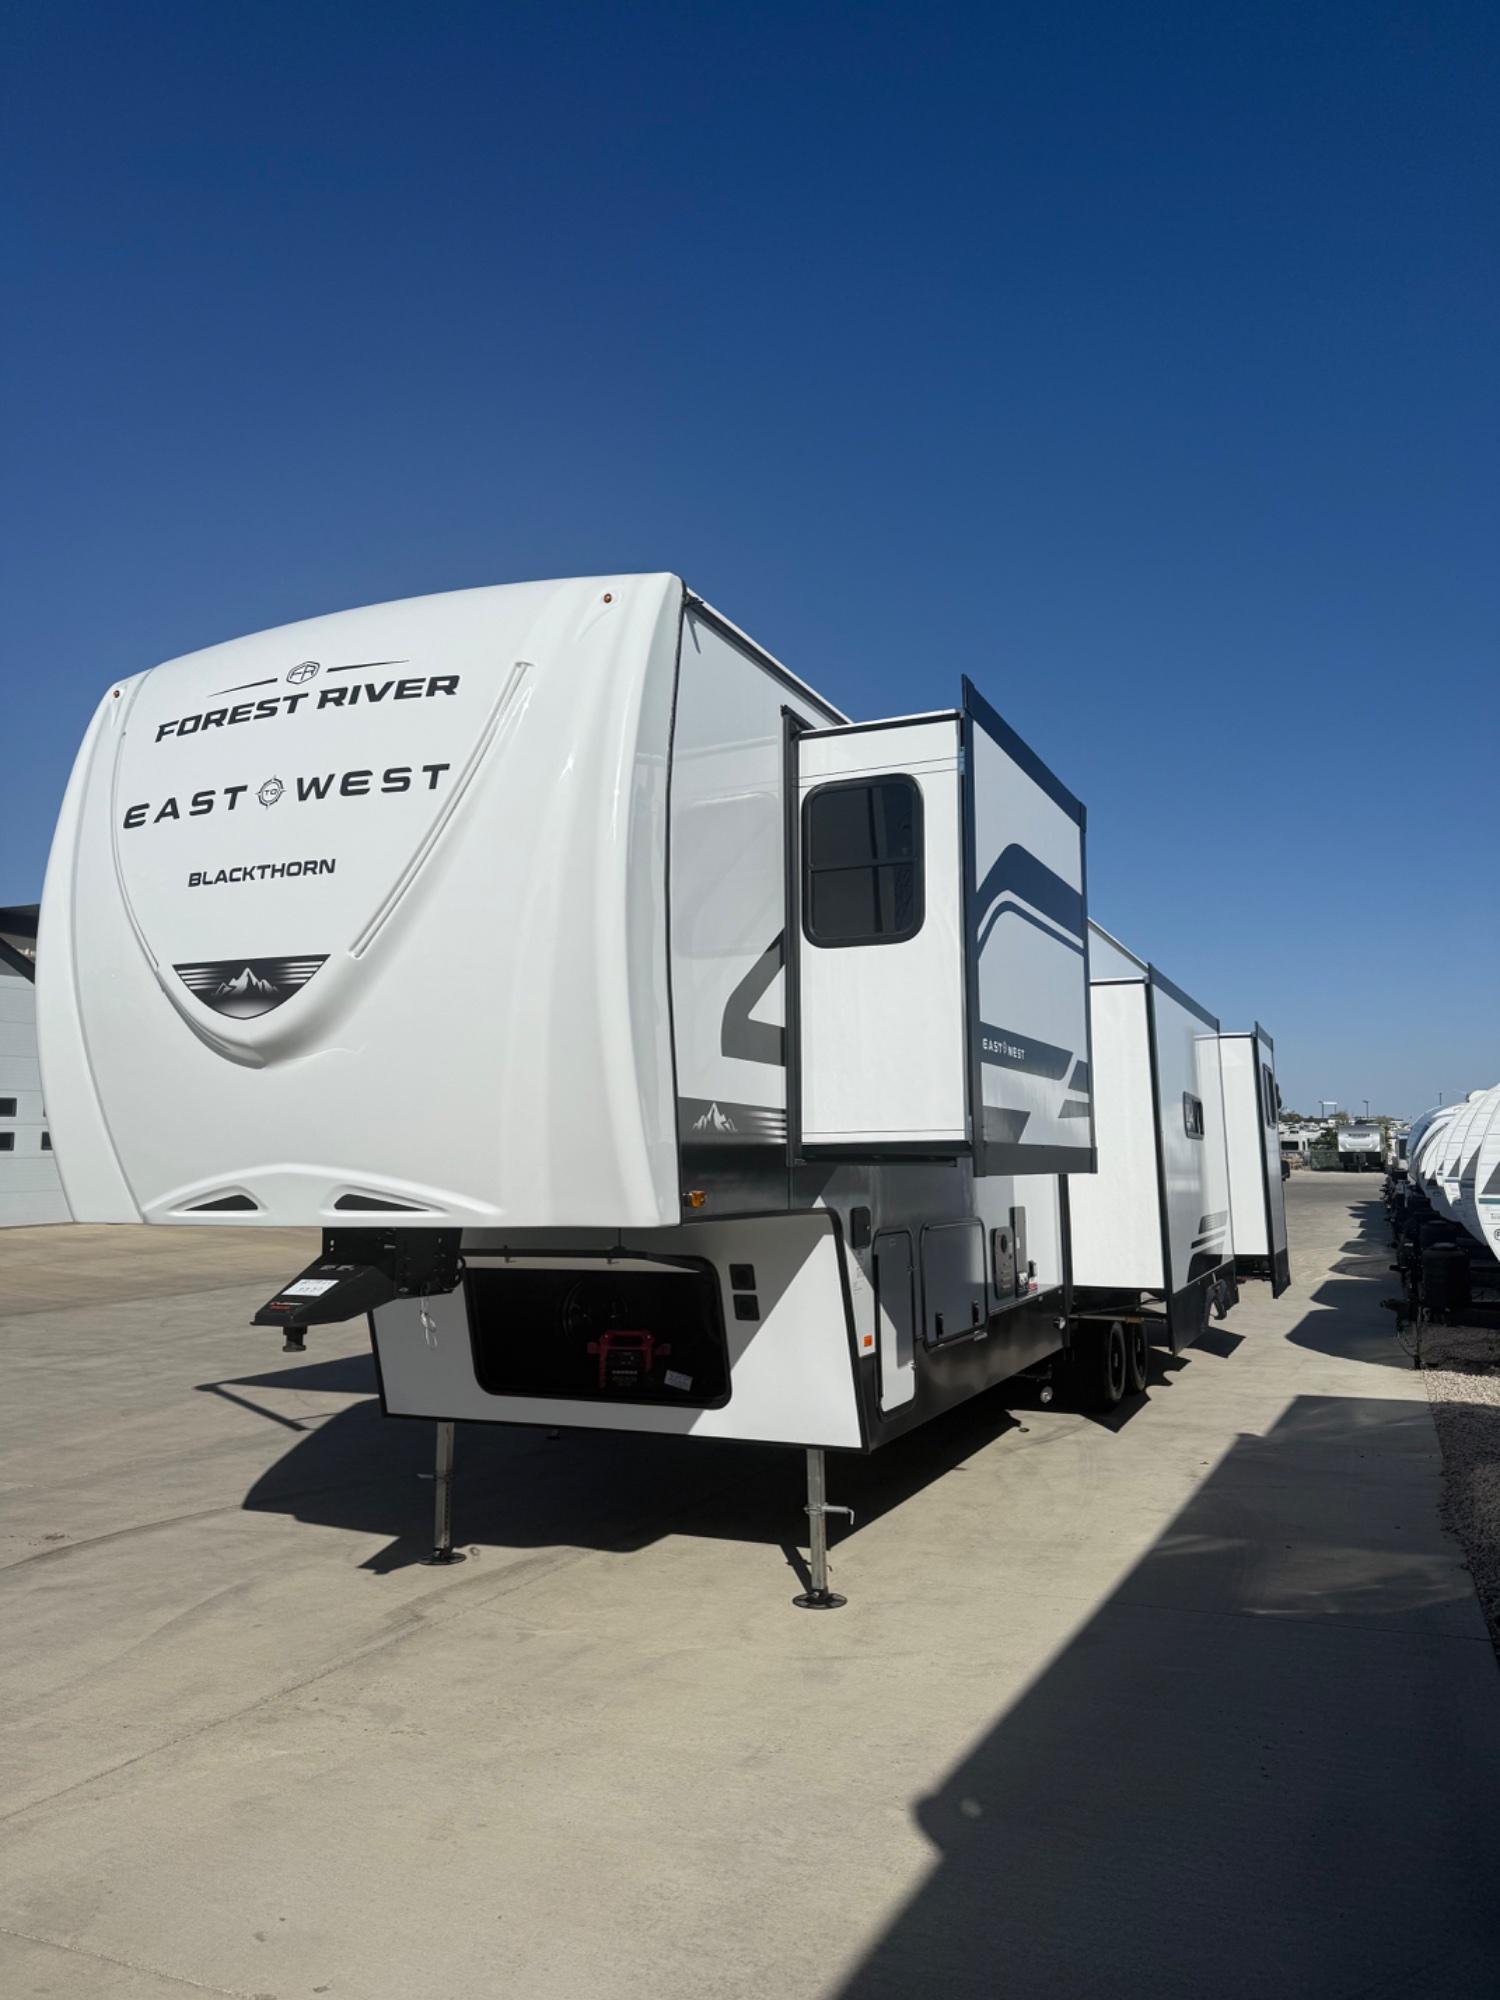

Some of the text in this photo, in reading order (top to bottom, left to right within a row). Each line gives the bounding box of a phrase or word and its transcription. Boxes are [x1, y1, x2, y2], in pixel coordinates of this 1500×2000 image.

[154, 675, 460, 743] FOREST RIVER
[122, 784, 249, 830] EAST
[296, 763, 451, 802] WEST
[187, 858, 337, 888] BLACKTHORN
[982, 1037, 1002, 1054] EAST
